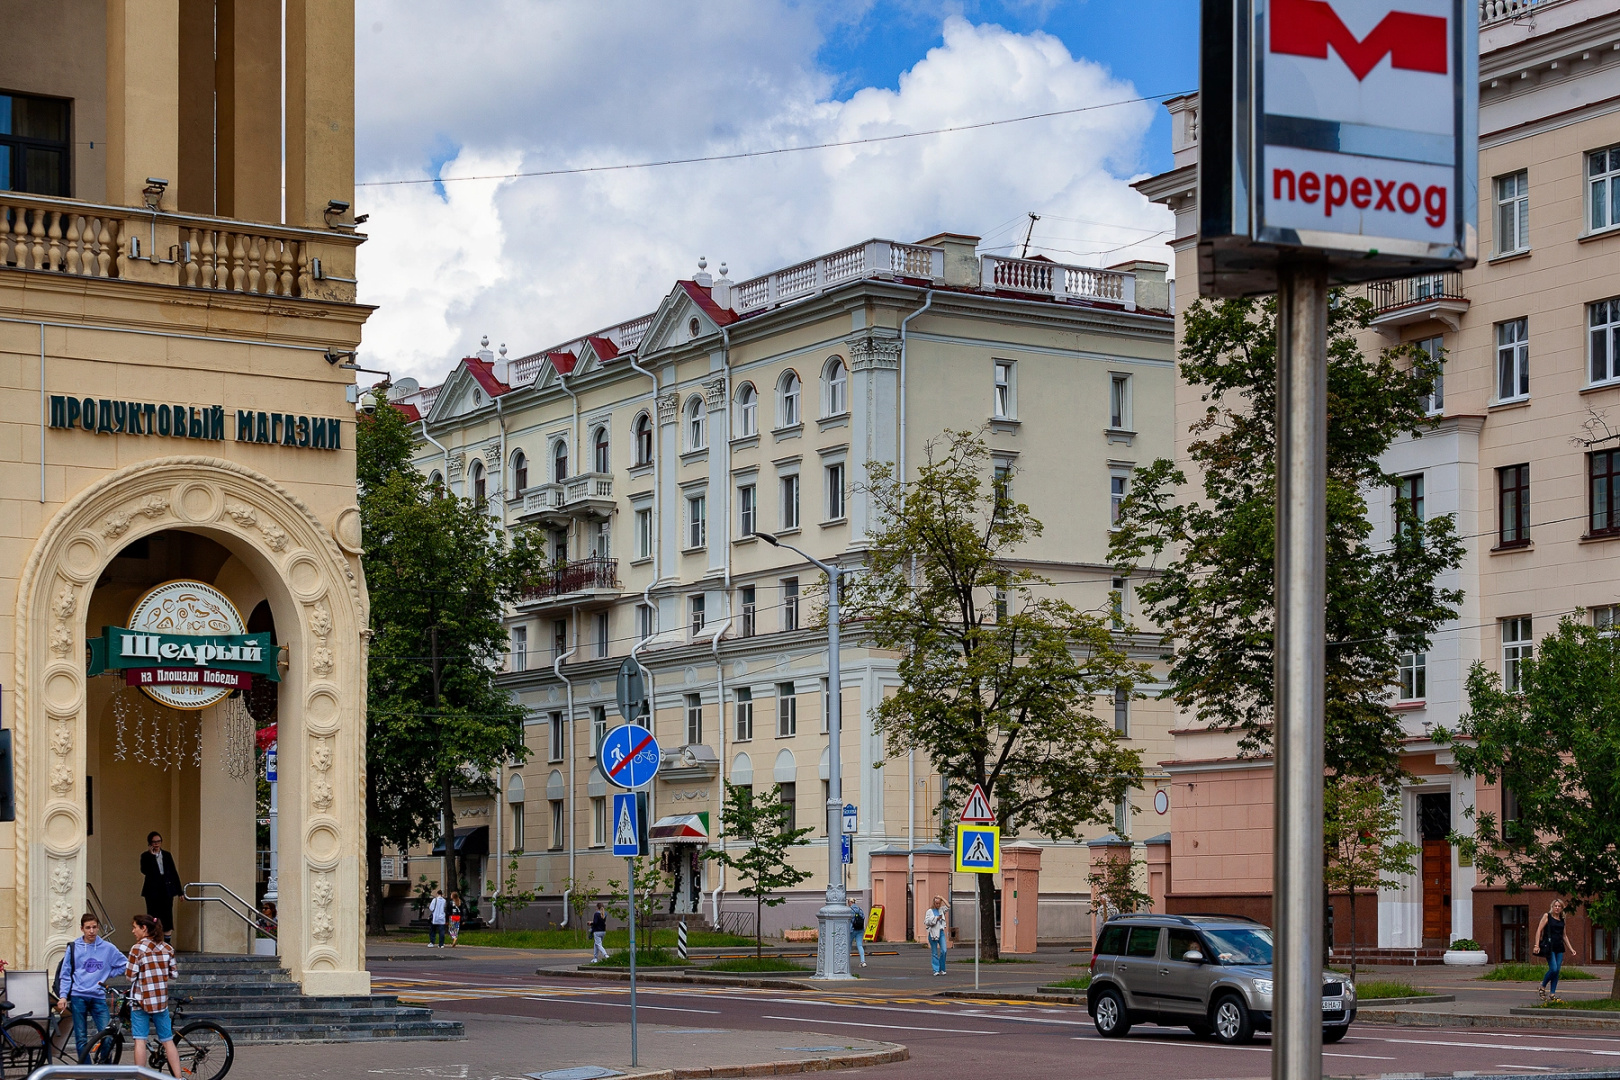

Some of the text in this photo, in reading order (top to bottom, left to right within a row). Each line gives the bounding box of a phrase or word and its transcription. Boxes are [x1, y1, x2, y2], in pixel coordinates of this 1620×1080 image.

[1273, 168, 1447, 228] переход
[49, 395, 342, 450] ПРОДУКТОВЫЙ МАГАЗИН
[120, 634, 263, 666] Щедрый
[140, 669, 239, 685] на Площади Победы
[171, 685, 186, 695] ОАО
[847, 818, 853, 830] 4
